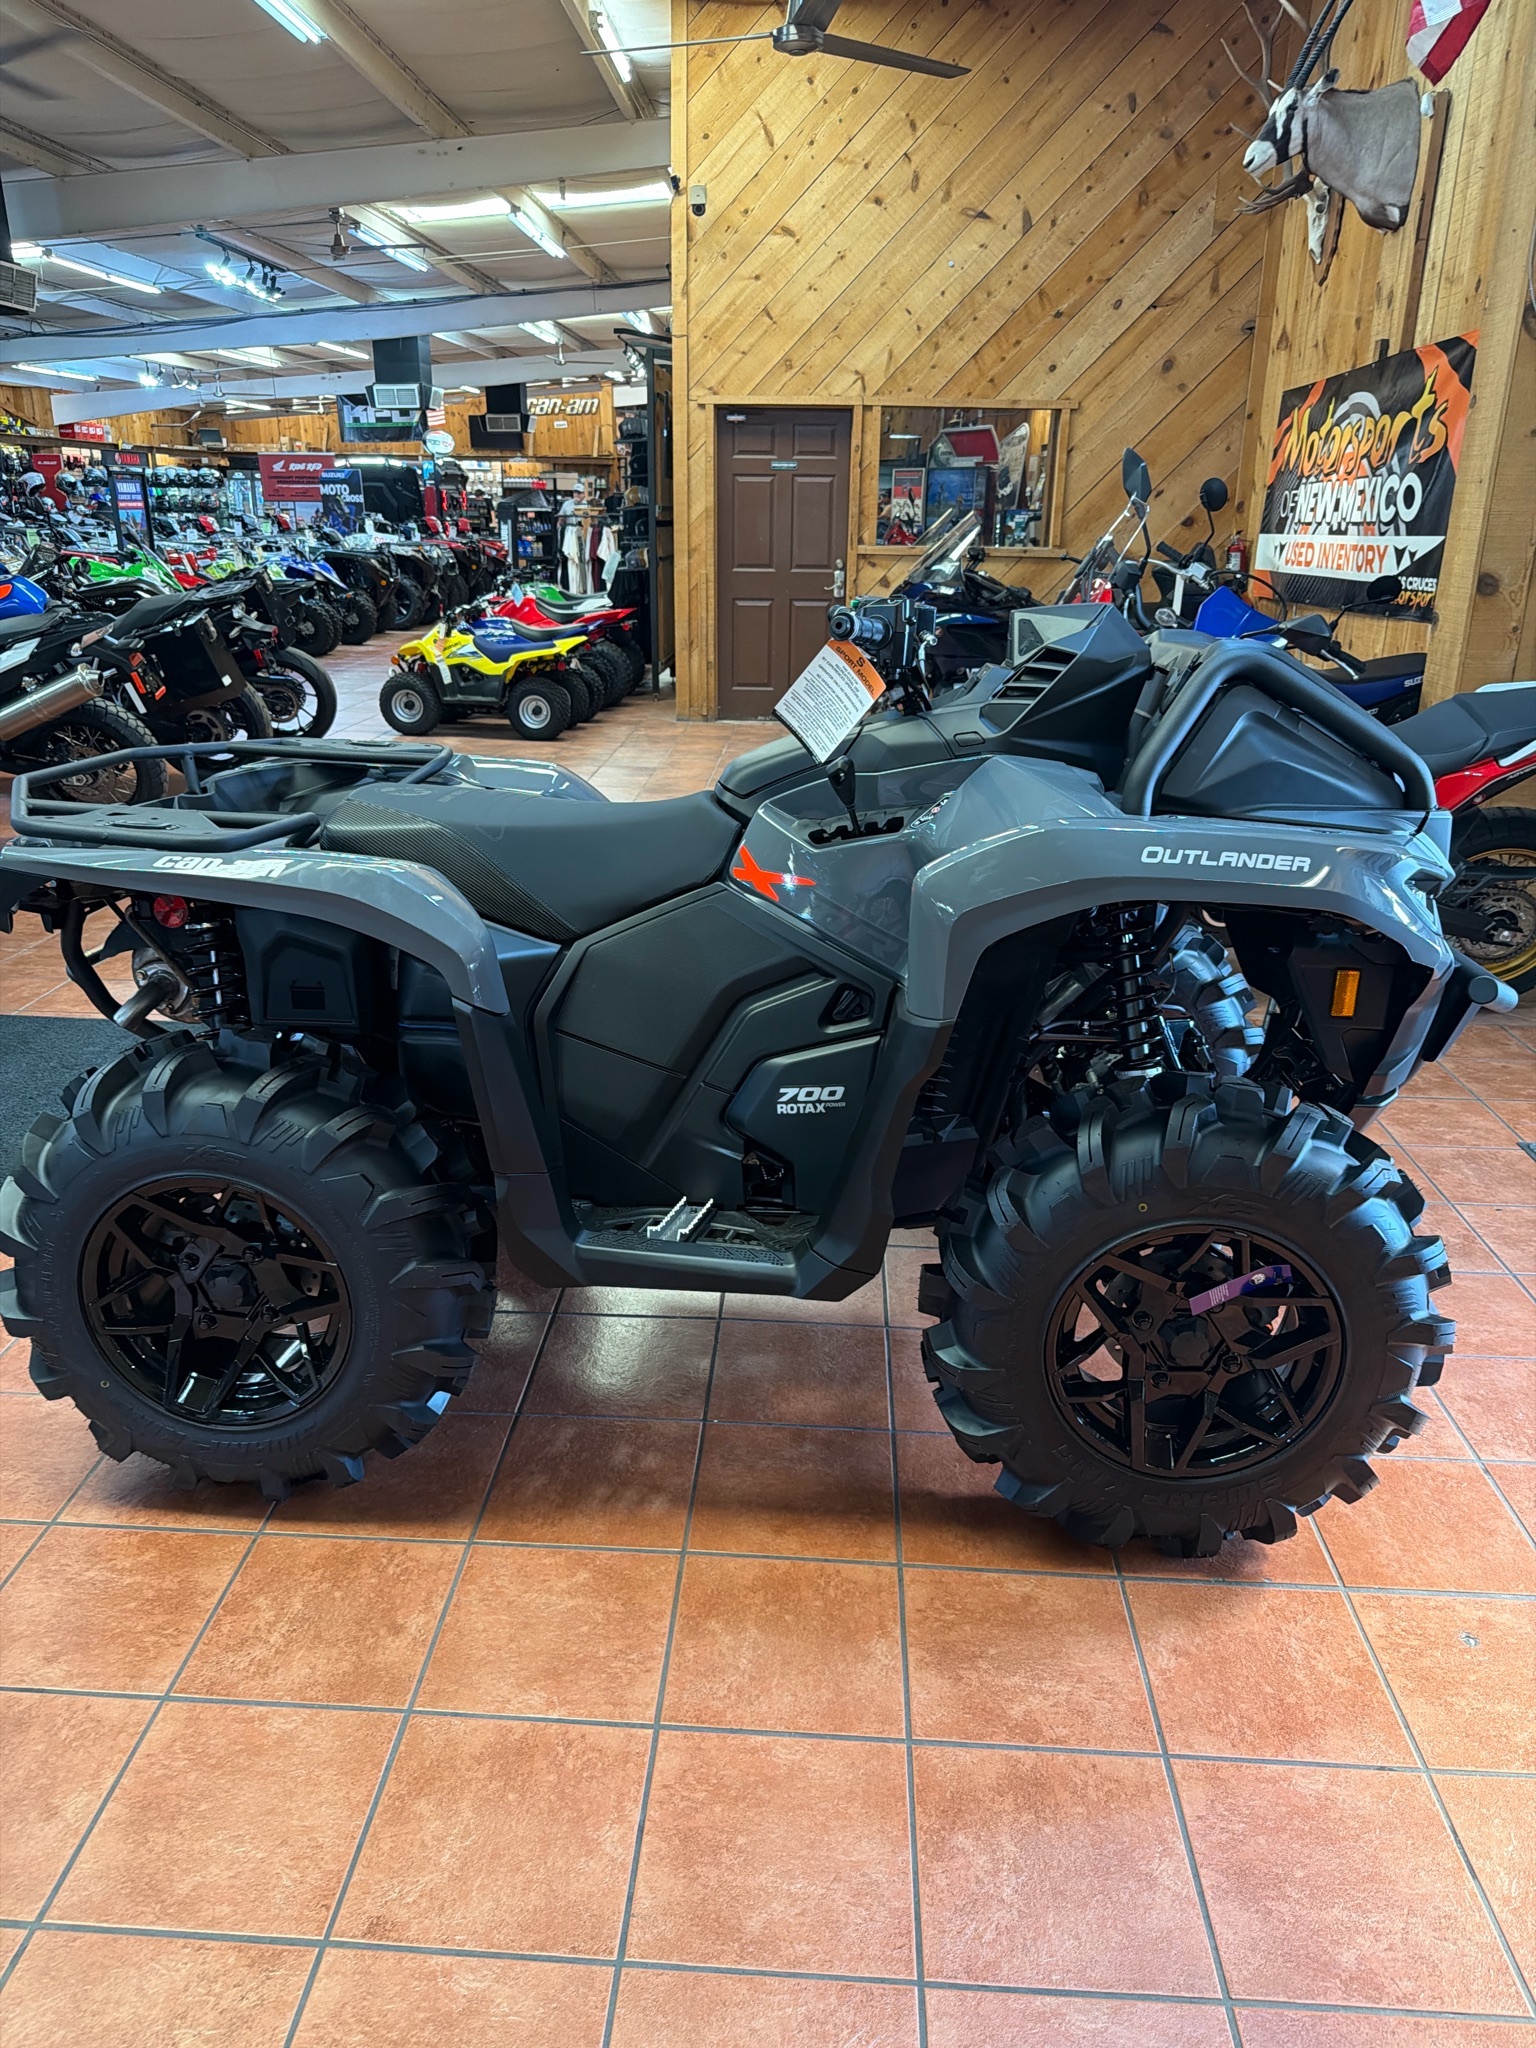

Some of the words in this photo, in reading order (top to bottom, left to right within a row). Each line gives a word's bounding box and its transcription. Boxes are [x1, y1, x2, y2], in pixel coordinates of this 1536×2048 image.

[527, 398, 599, 415] can-am
[320, 484, 349, 495] MOTO
[341, 494, 364, 503] CROSS
[1280, 490, 1297, 519] OF
[1295, 478, 1337, 524] NEW
[1338, 472, 1423, 524] MEXICO
[1284, 543, 1313, 568] USED
[1316, 542, 1389, 573] INVENTORY
[1406, 576, 1437, 592] CRUCES
[856, 656, 866, 668] S
[835, 646, 857, 669] SPORT
[855, 668, 876, 695] MODEL
[1403, 675, 1424, 687] SUZ
[1140, 846, 1311, 872] OUTLANDER
[777, 1086, 845, 1102] 700
[776, 1103, 826, 1114] ROTAX
